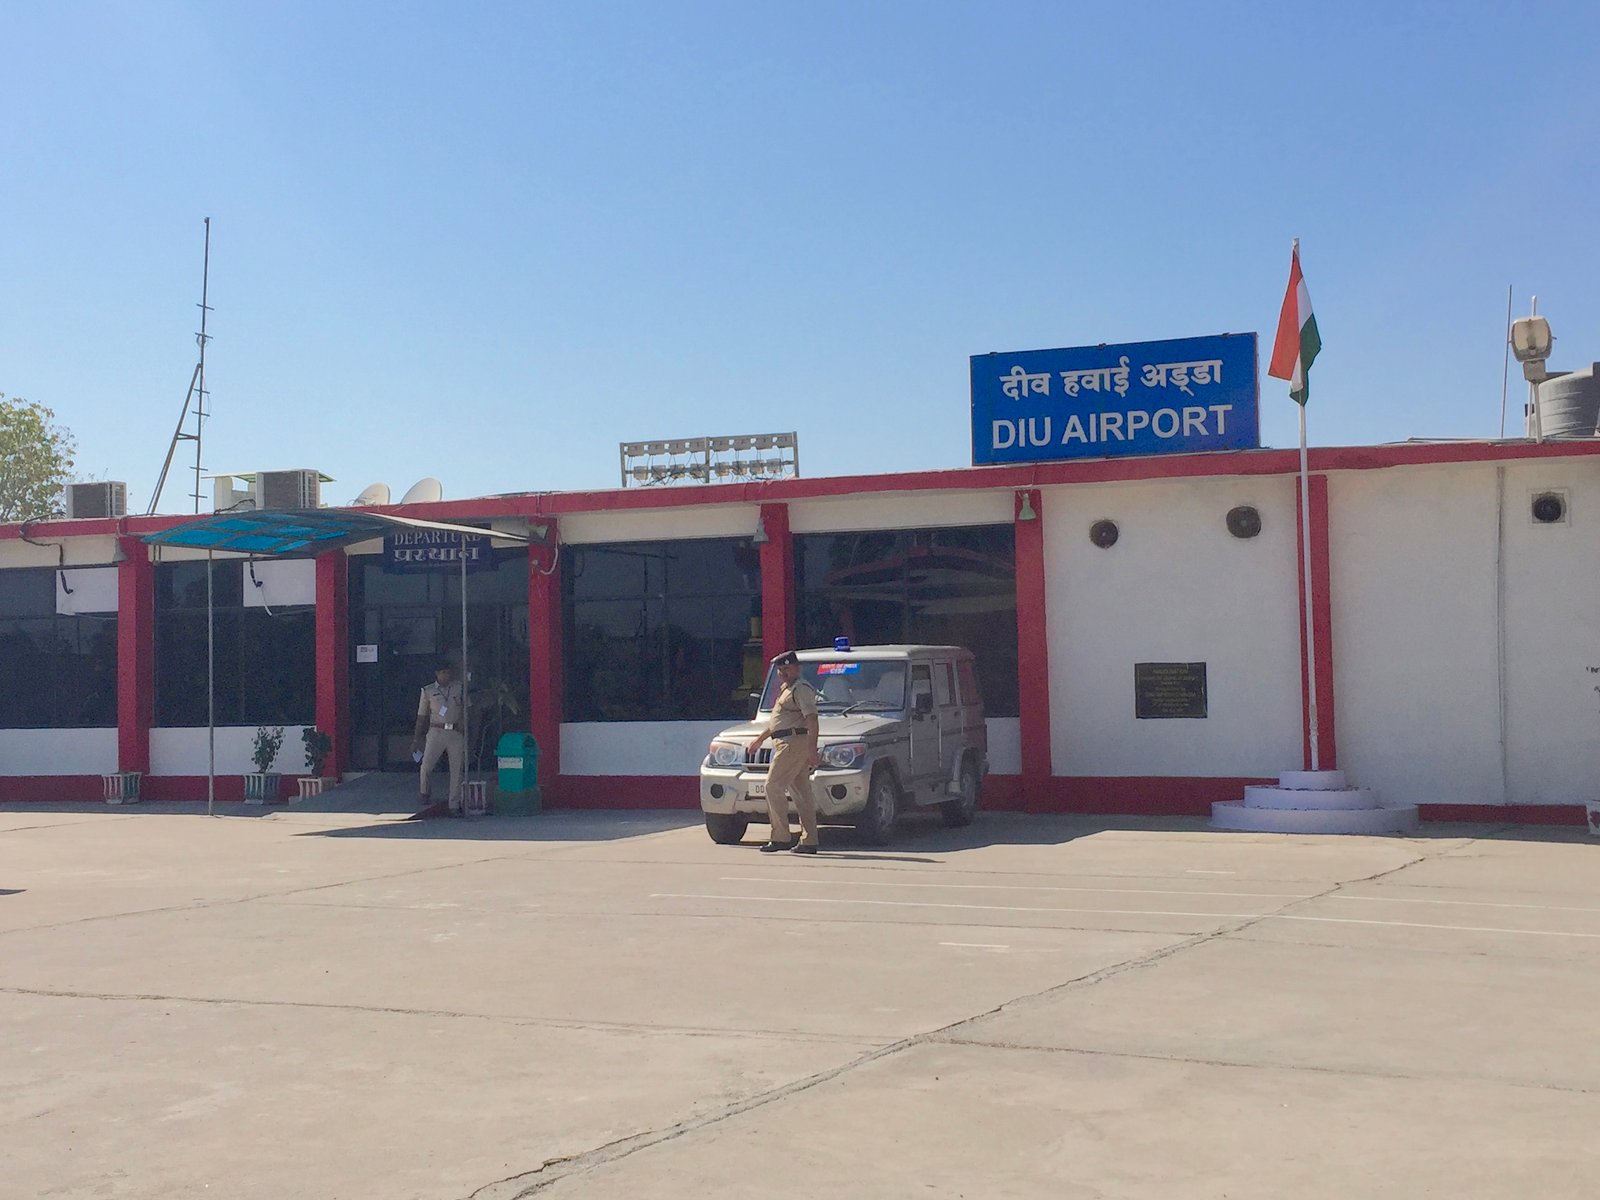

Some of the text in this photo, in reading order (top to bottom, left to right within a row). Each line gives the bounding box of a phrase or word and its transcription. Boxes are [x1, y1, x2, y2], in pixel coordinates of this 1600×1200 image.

[999, 365, 1051, 400] दीव
[1060, 356, 1130, 398] हवाई
[992, 404, 1233, 449] DIU AIRPORT
